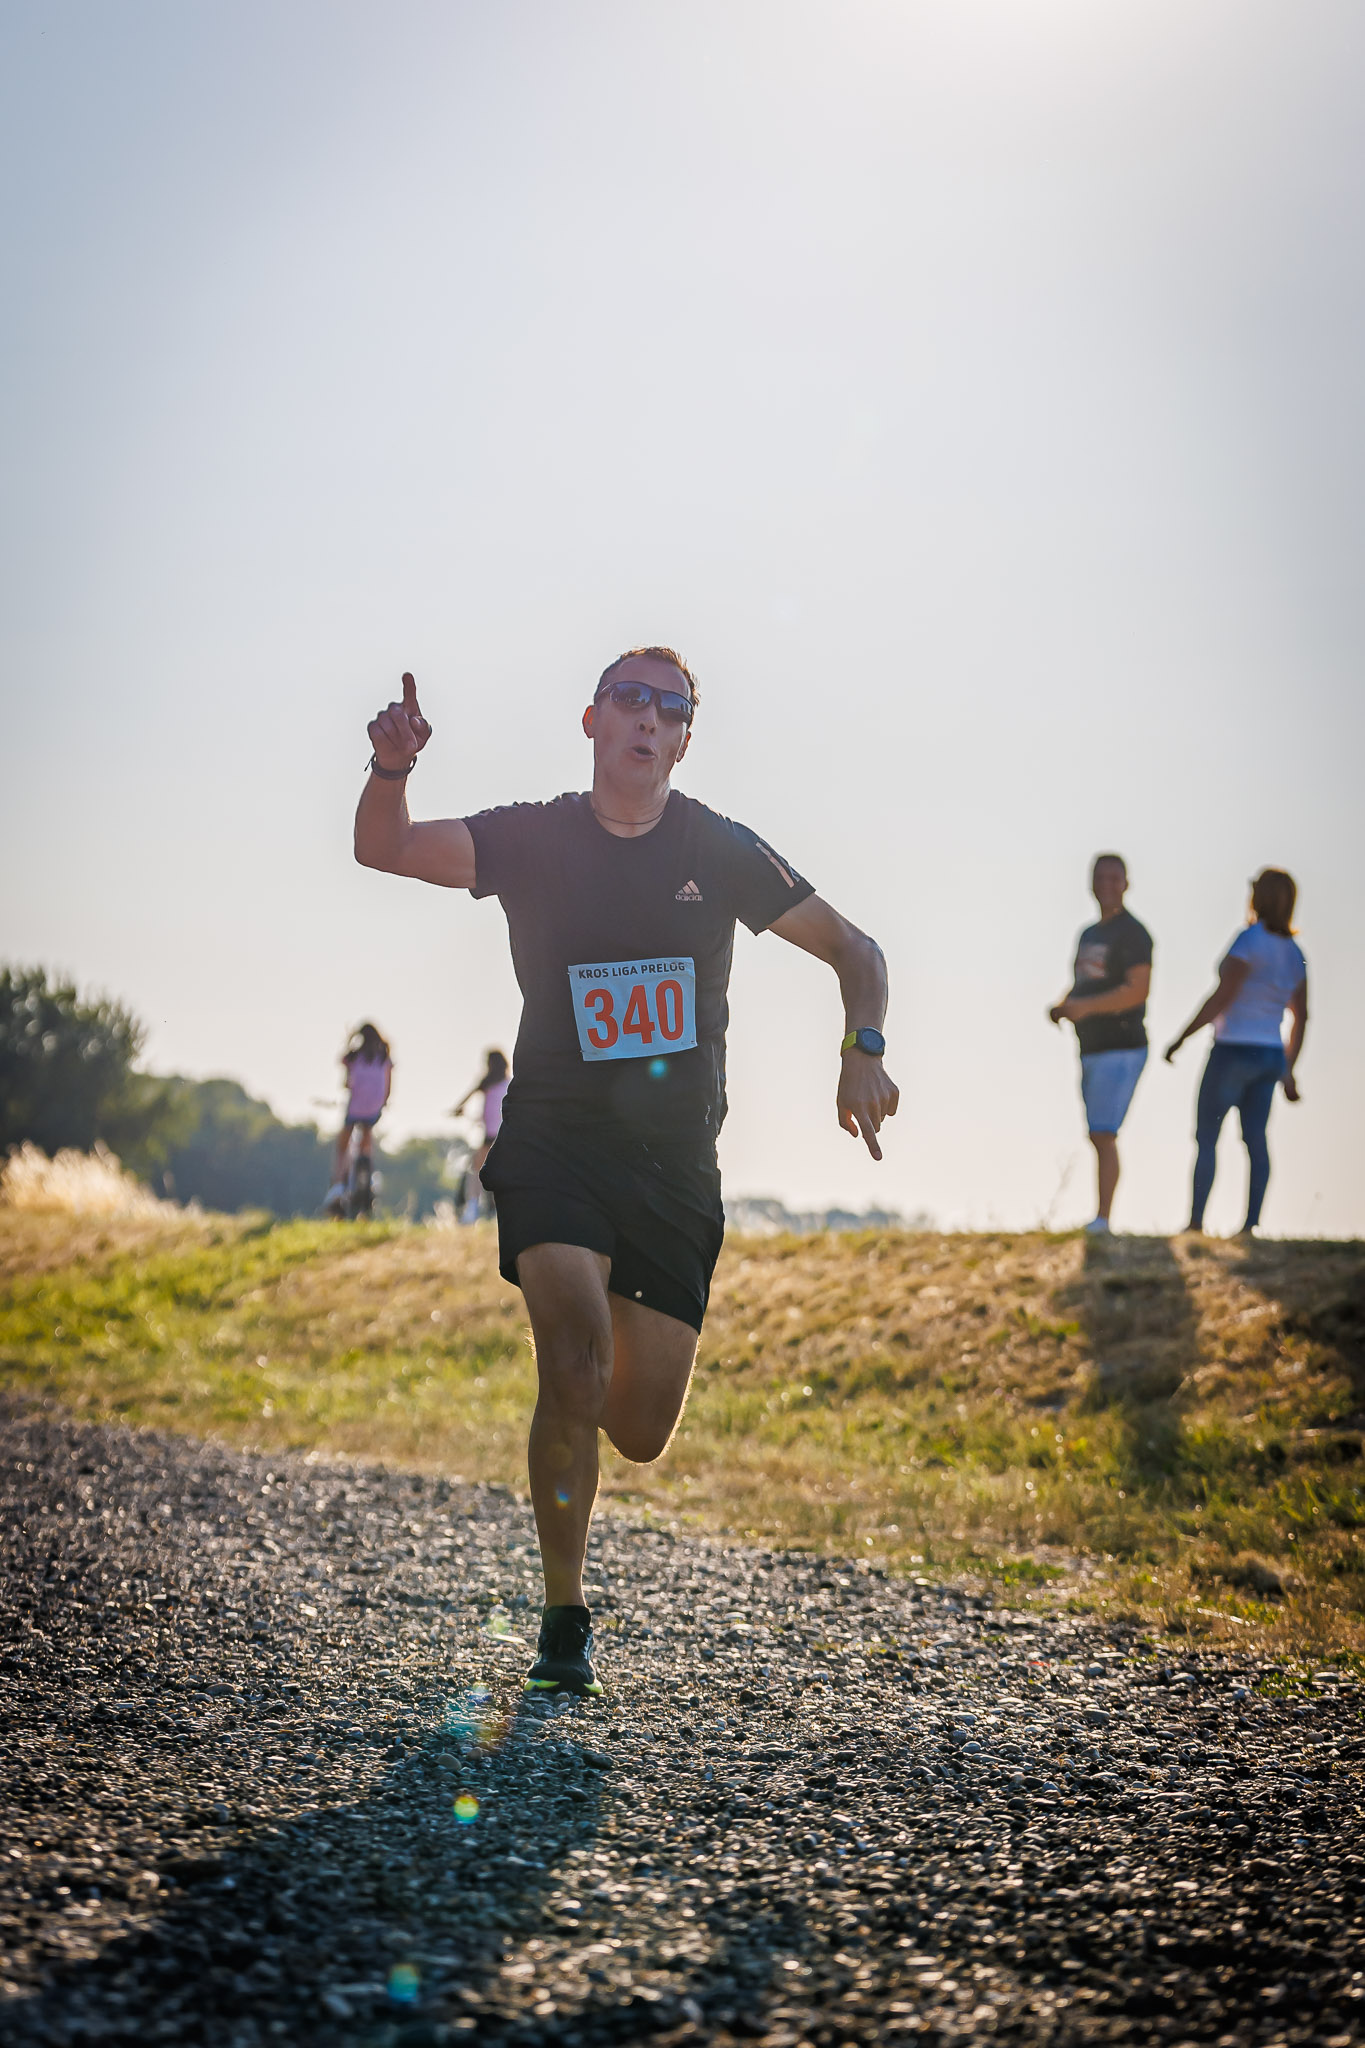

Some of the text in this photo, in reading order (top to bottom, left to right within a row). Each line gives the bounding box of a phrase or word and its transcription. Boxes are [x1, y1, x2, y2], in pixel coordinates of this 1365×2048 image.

[579, 962, 685, 979] KROS LIGA PRELOG
[584, 979, 684, 1048] 340
